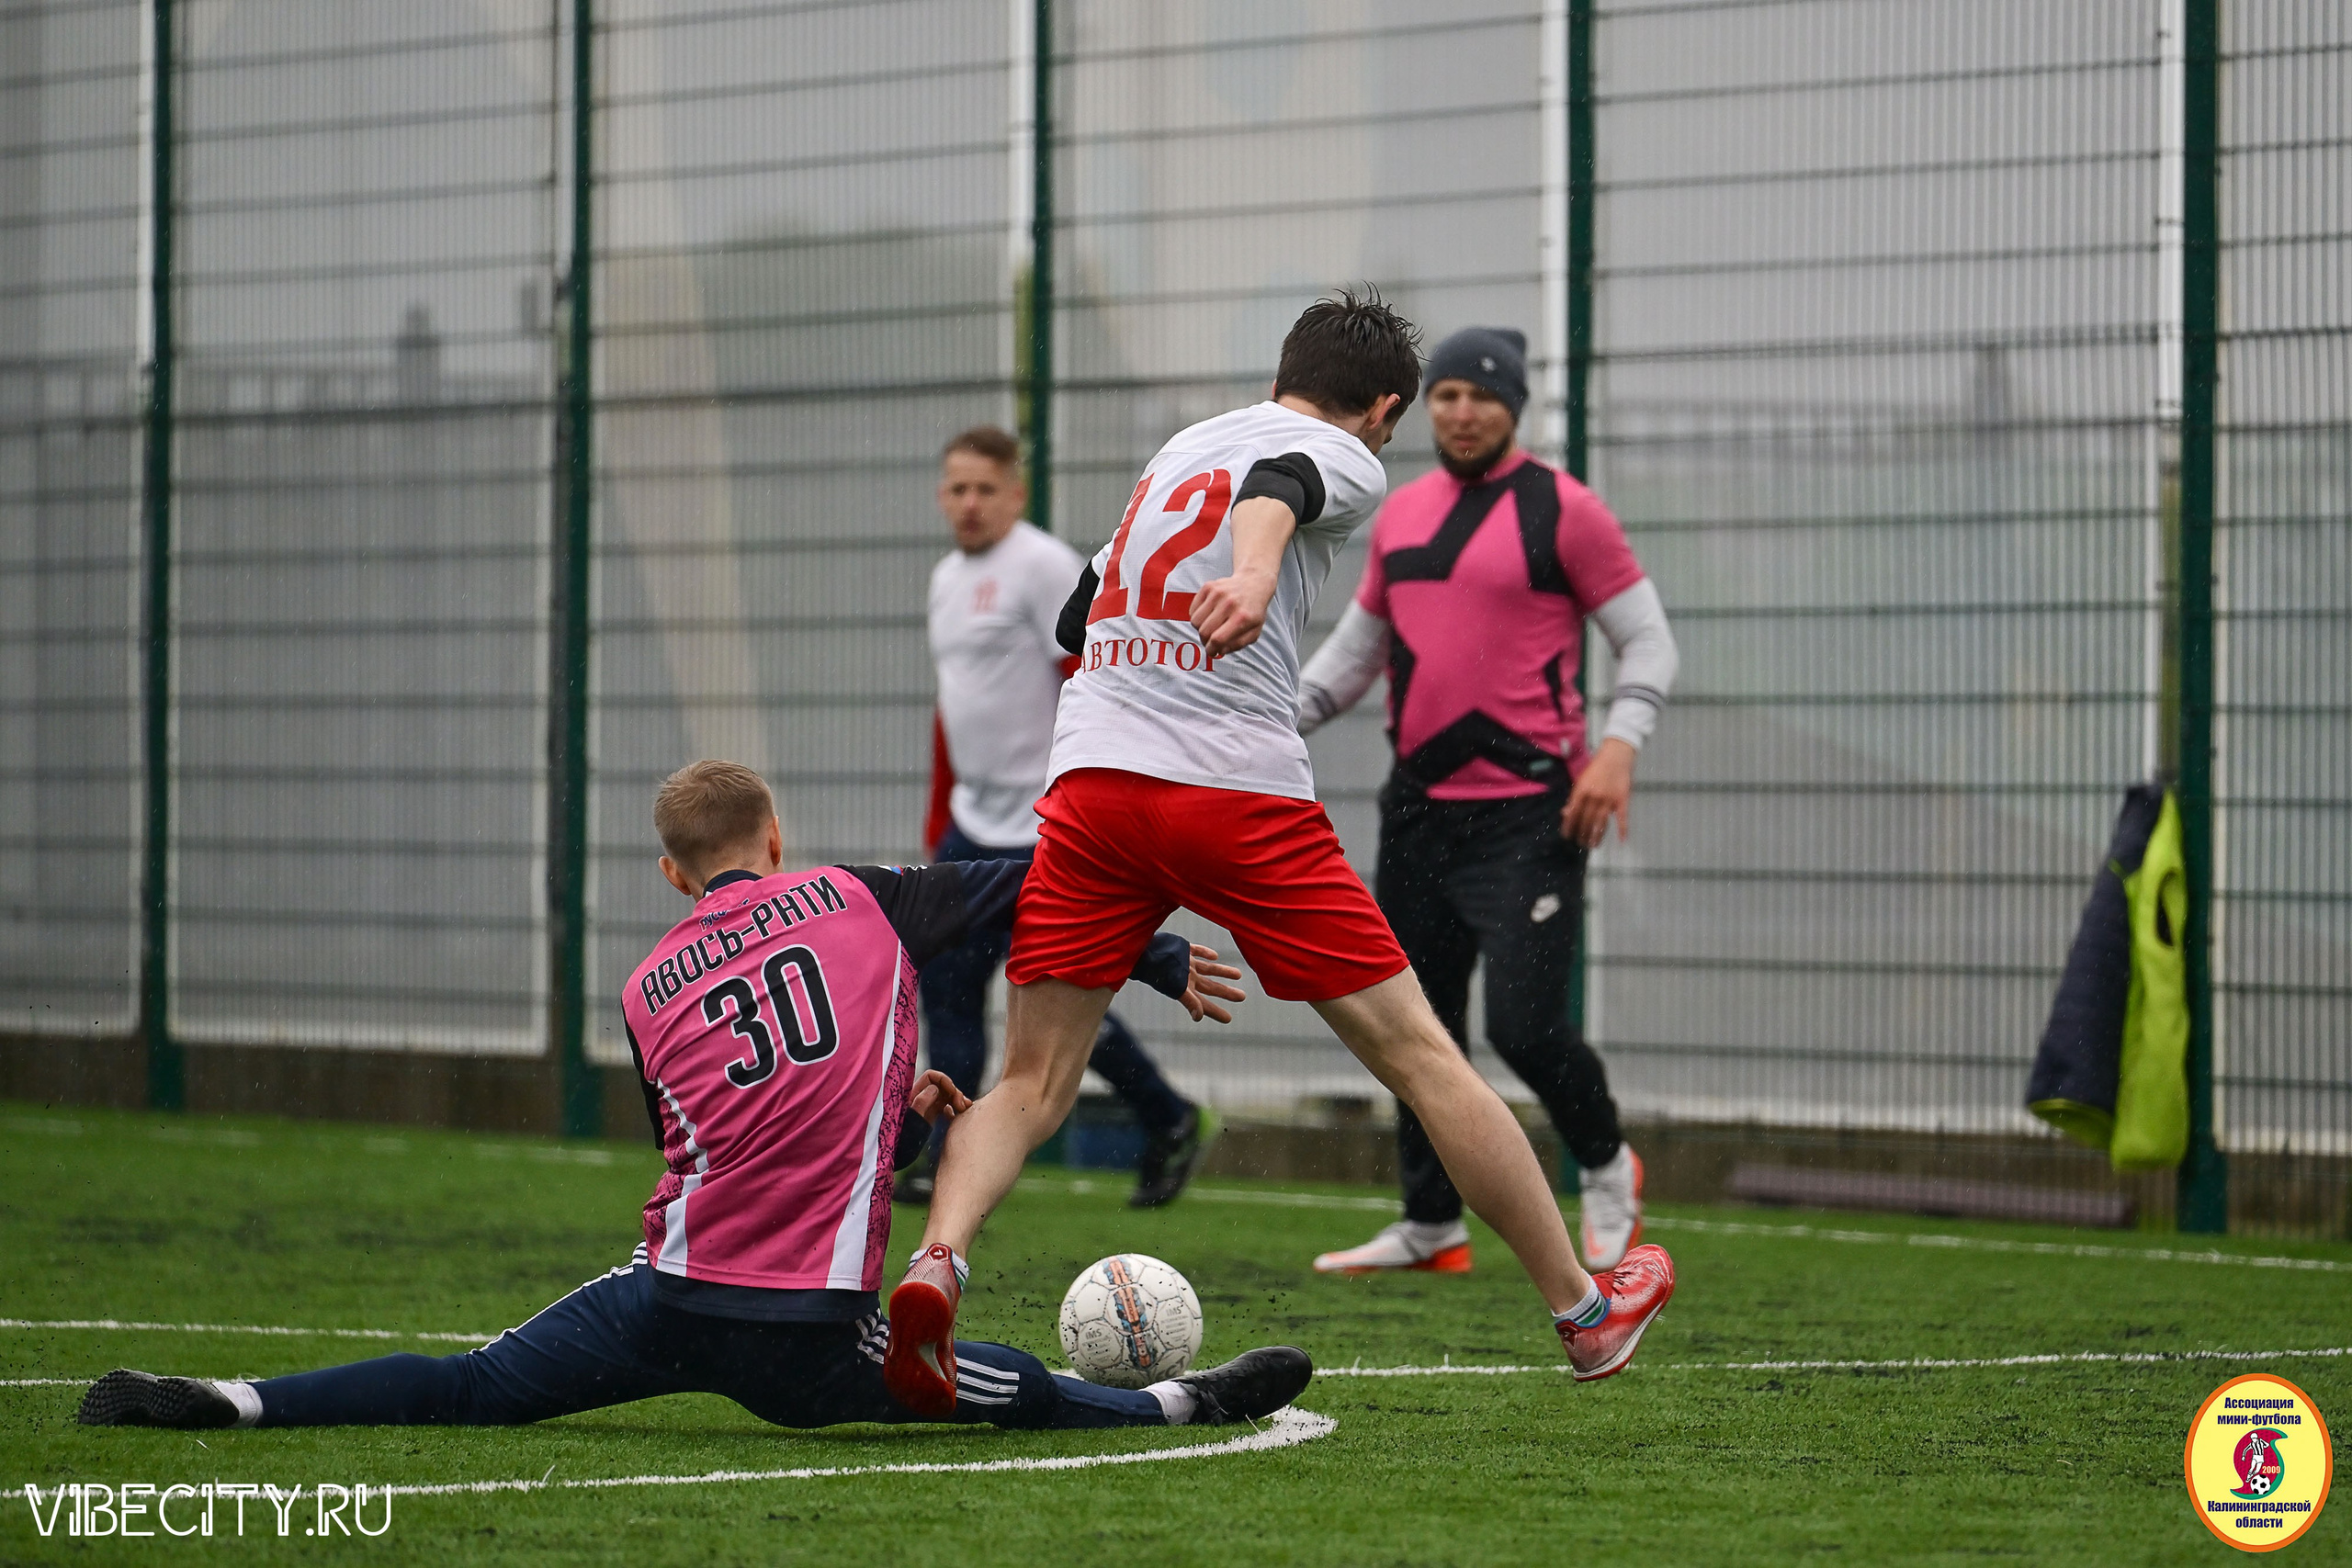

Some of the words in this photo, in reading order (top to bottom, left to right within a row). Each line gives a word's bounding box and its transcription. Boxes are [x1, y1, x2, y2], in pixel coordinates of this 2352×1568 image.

[1086, 468, 1232, 626] 12
[640, 874, 847, 1016] АВОСЬ-РАТИ
[700, 943, 840, 1089] 30
[1085, 1328, 1102, 1340] IMS
[1166, 1306, 1182, 1316] IMS
